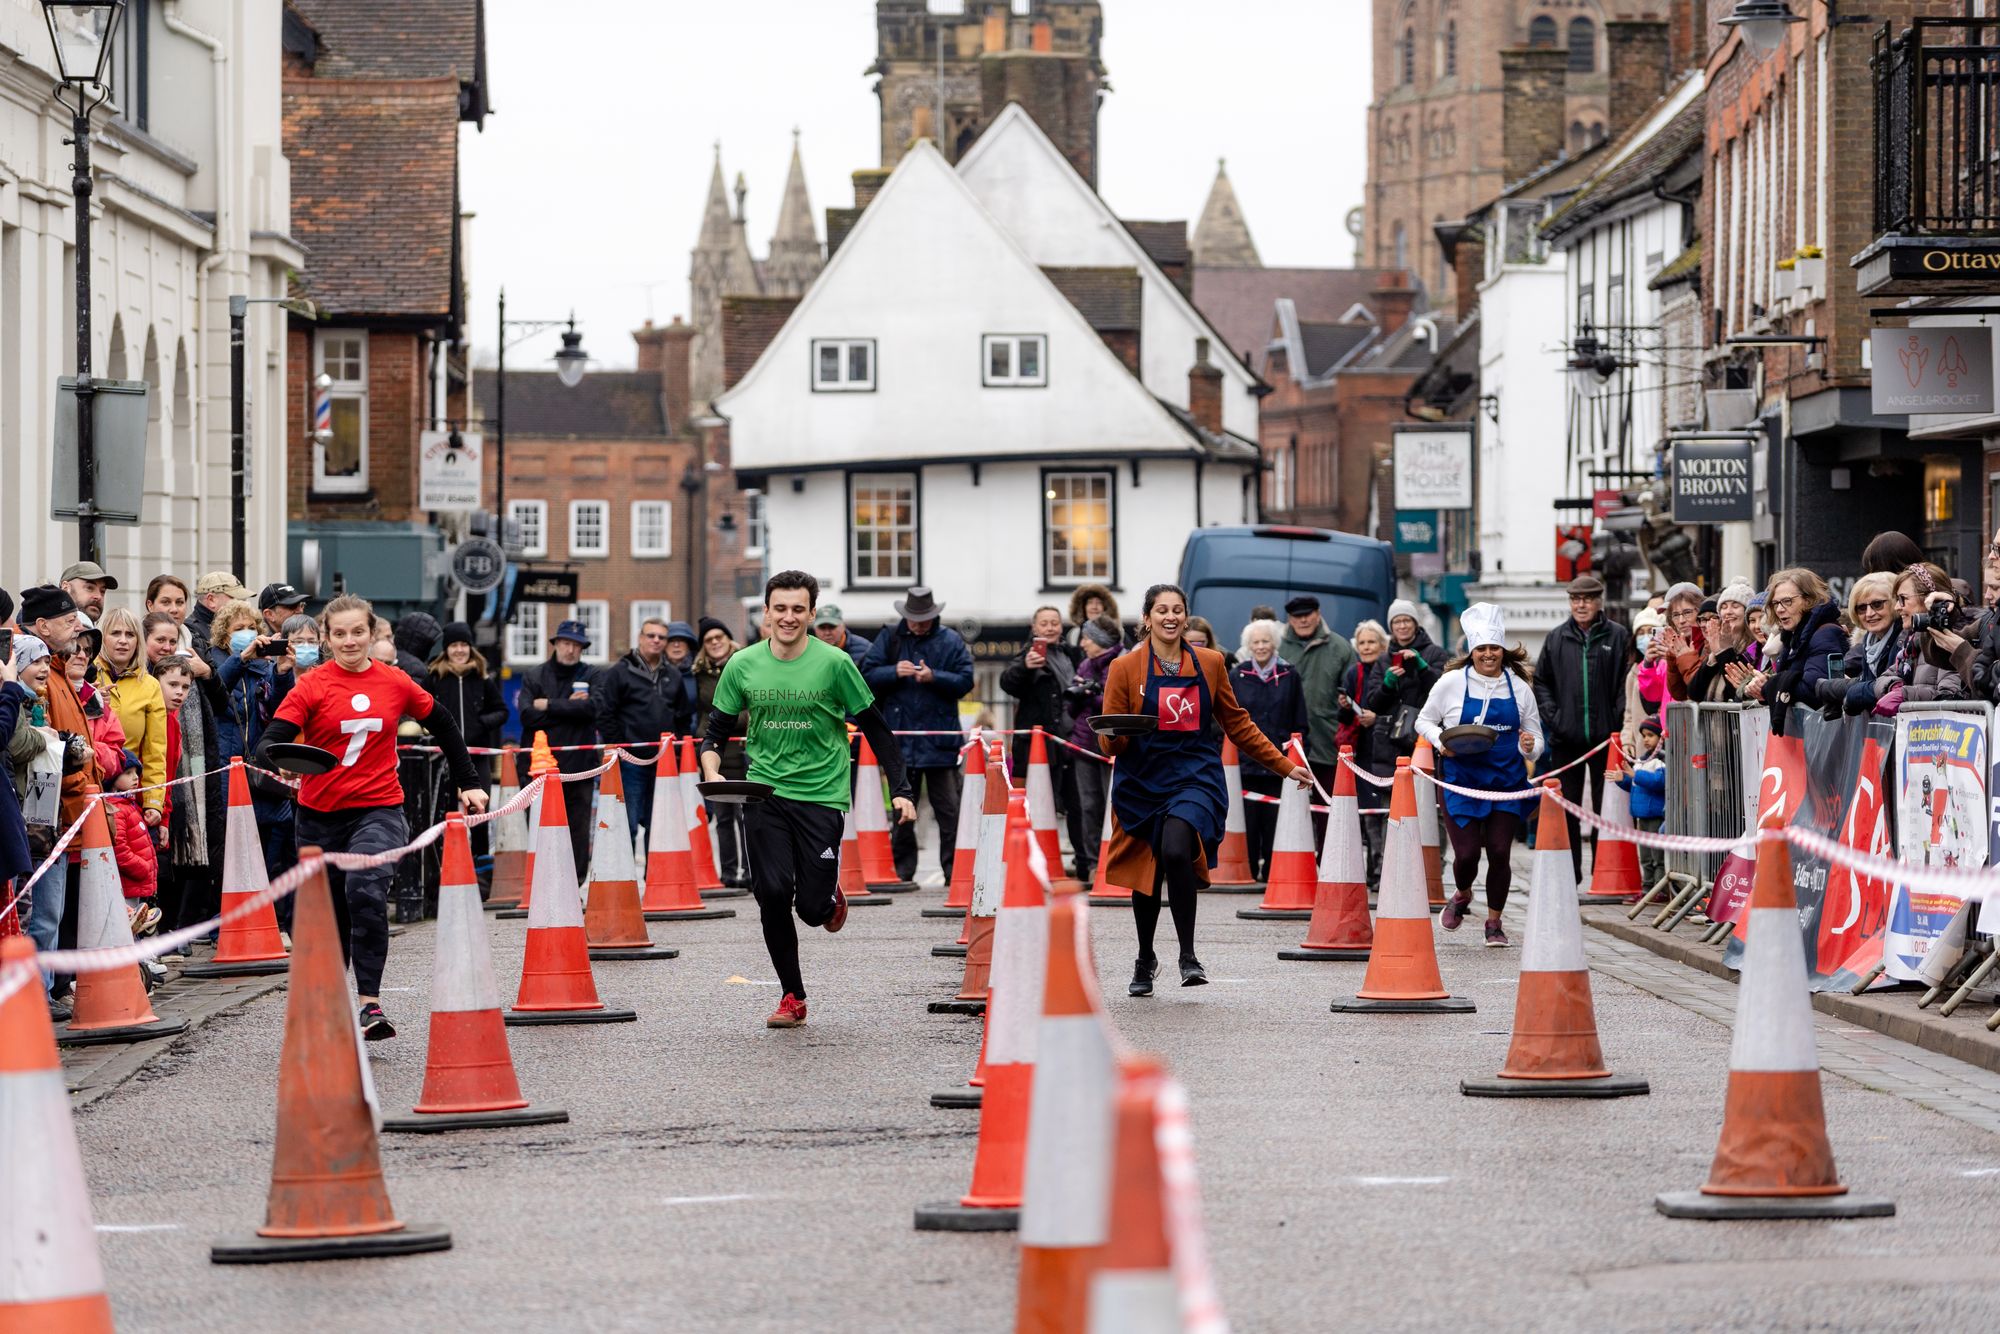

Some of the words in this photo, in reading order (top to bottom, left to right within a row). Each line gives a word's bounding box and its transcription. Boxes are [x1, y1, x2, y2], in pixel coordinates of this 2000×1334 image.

[1679, 458, 1747, 476] MOLTON
[1679, 478, 1747, 495] BROWN
[1691, 498, 1736, 506] LONDON
[763, 721, 812, 729] SOLICITORS
